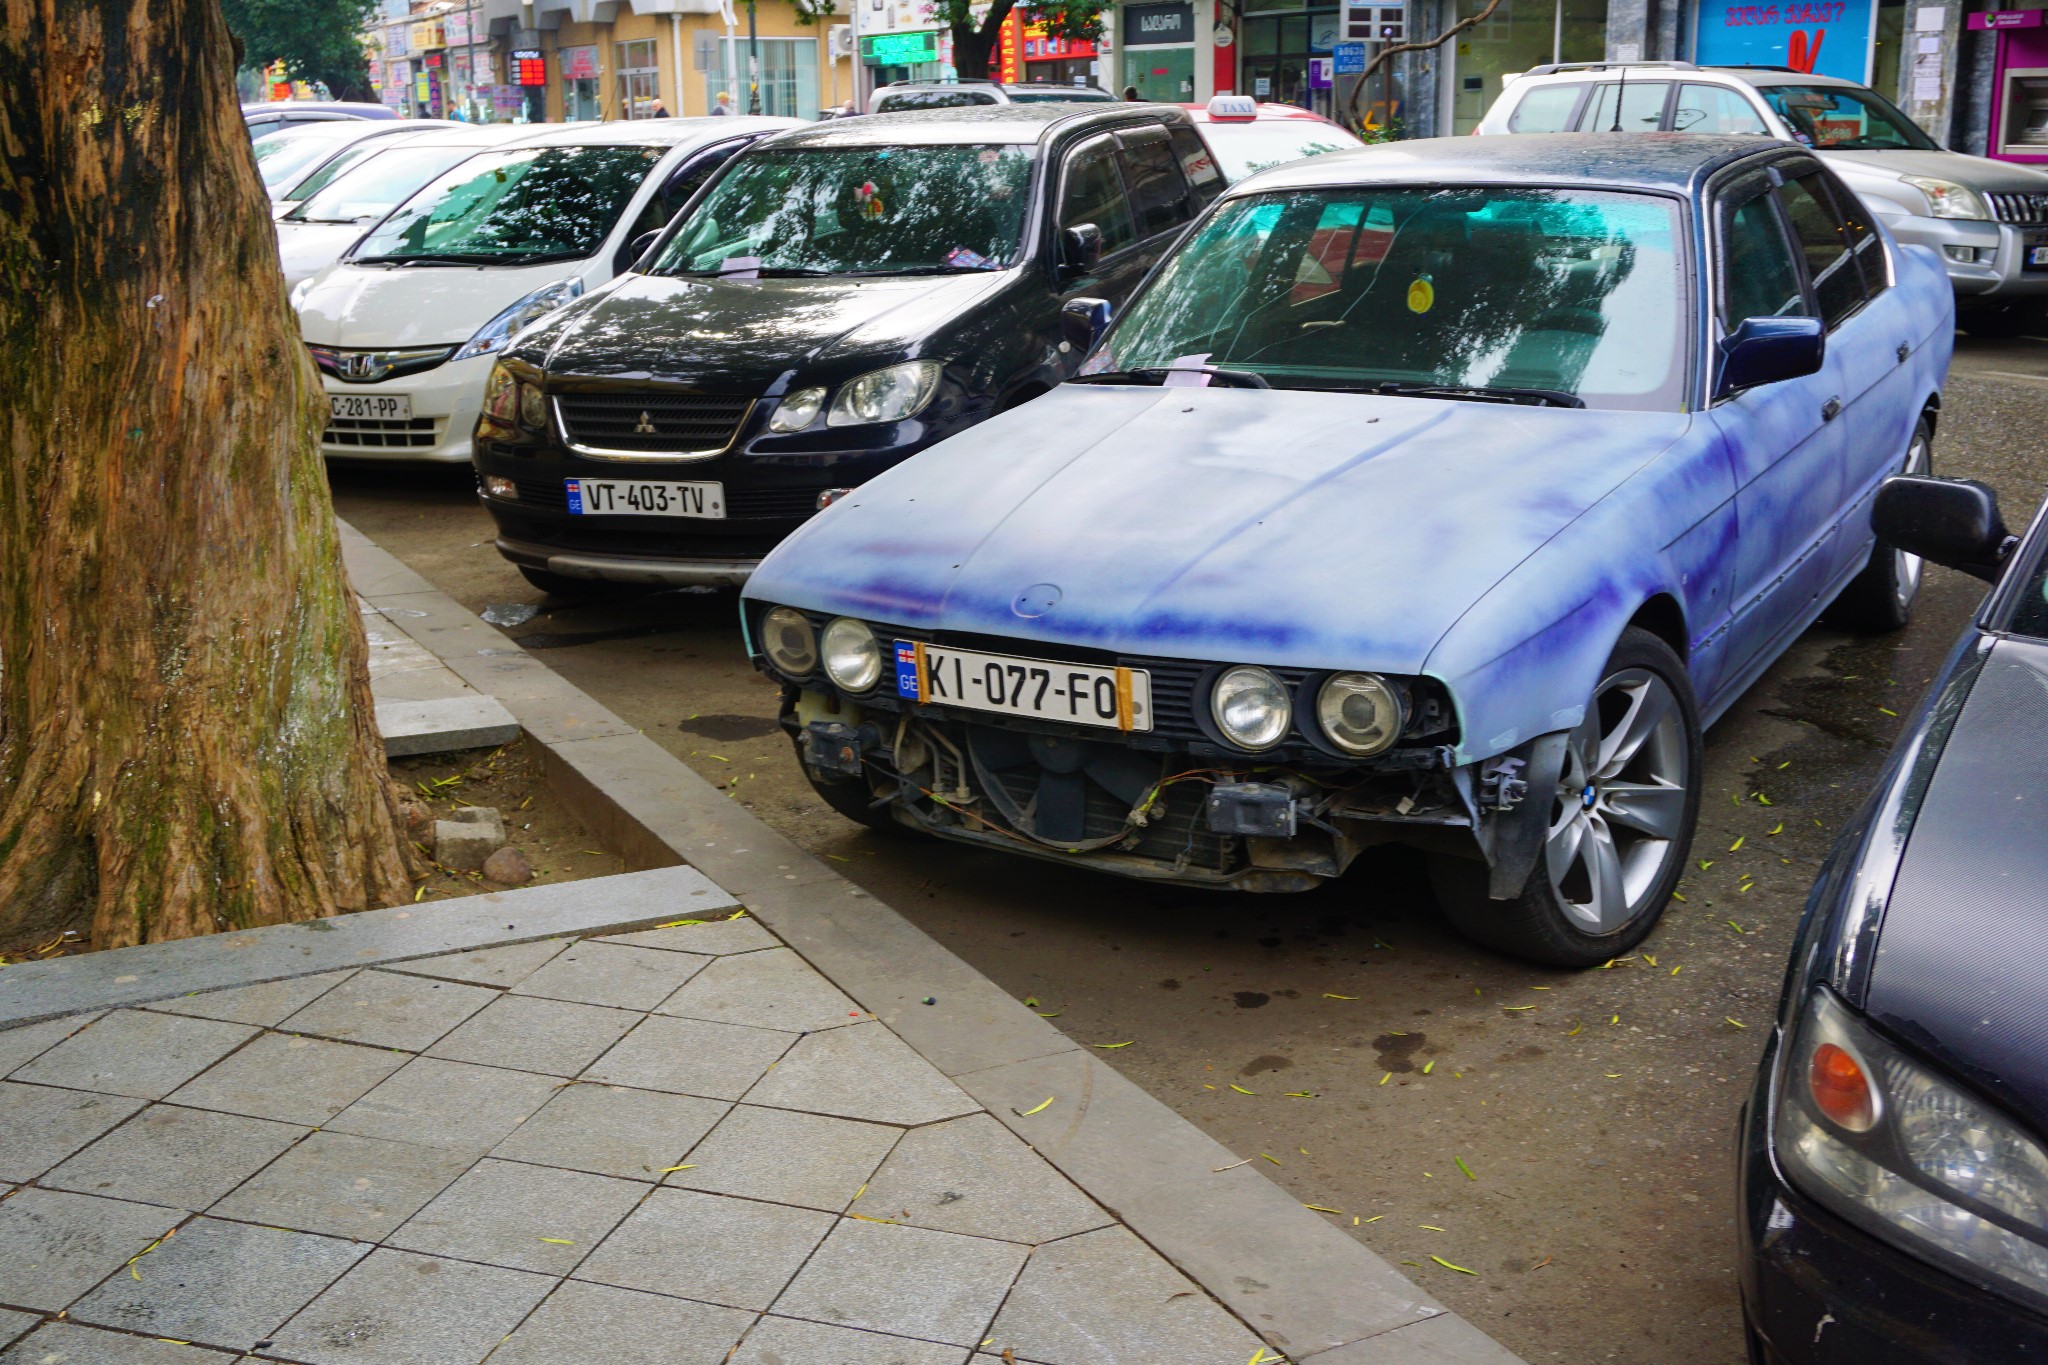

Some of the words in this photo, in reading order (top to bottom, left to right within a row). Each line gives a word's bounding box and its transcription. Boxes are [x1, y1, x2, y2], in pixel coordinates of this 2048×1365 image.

[1220, 103, 1253, 113] TAXI
[330, 396, 398, 417] C-281-PP
[569, 499, 582, 511] GE
[586, 483, 704, 514] VT-403-TV
[899, 673, 919, 692] GE
[926, 653, 1118, 720] KI-077-FO
